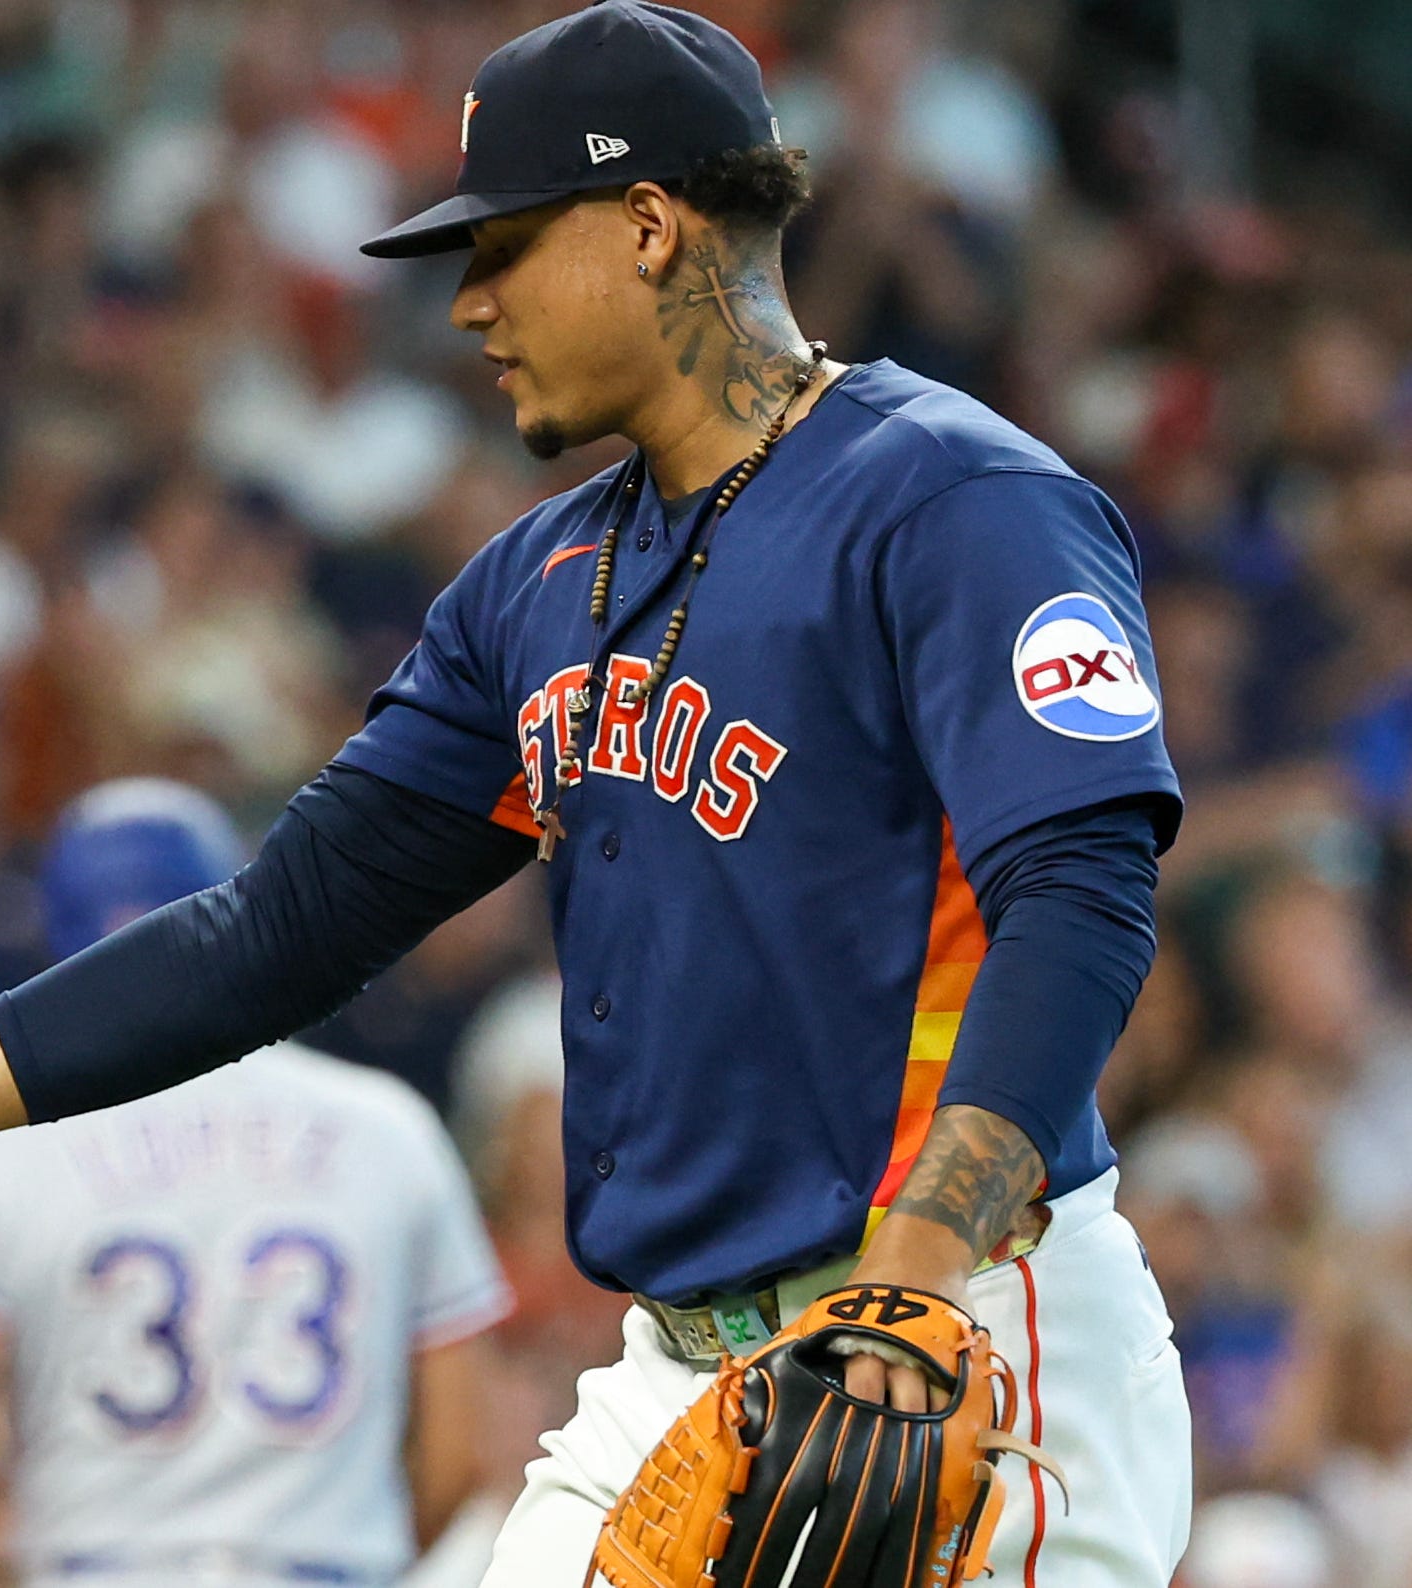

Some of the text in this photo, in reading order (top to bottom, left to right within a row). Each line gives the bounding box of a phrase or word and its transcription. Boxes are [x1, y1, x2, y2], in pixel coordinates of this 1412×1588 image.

[518, 653, 788, 842] STROS
[1022, 649, 1139, 701] OXY
[85, 1226, 354, 1434] 33
